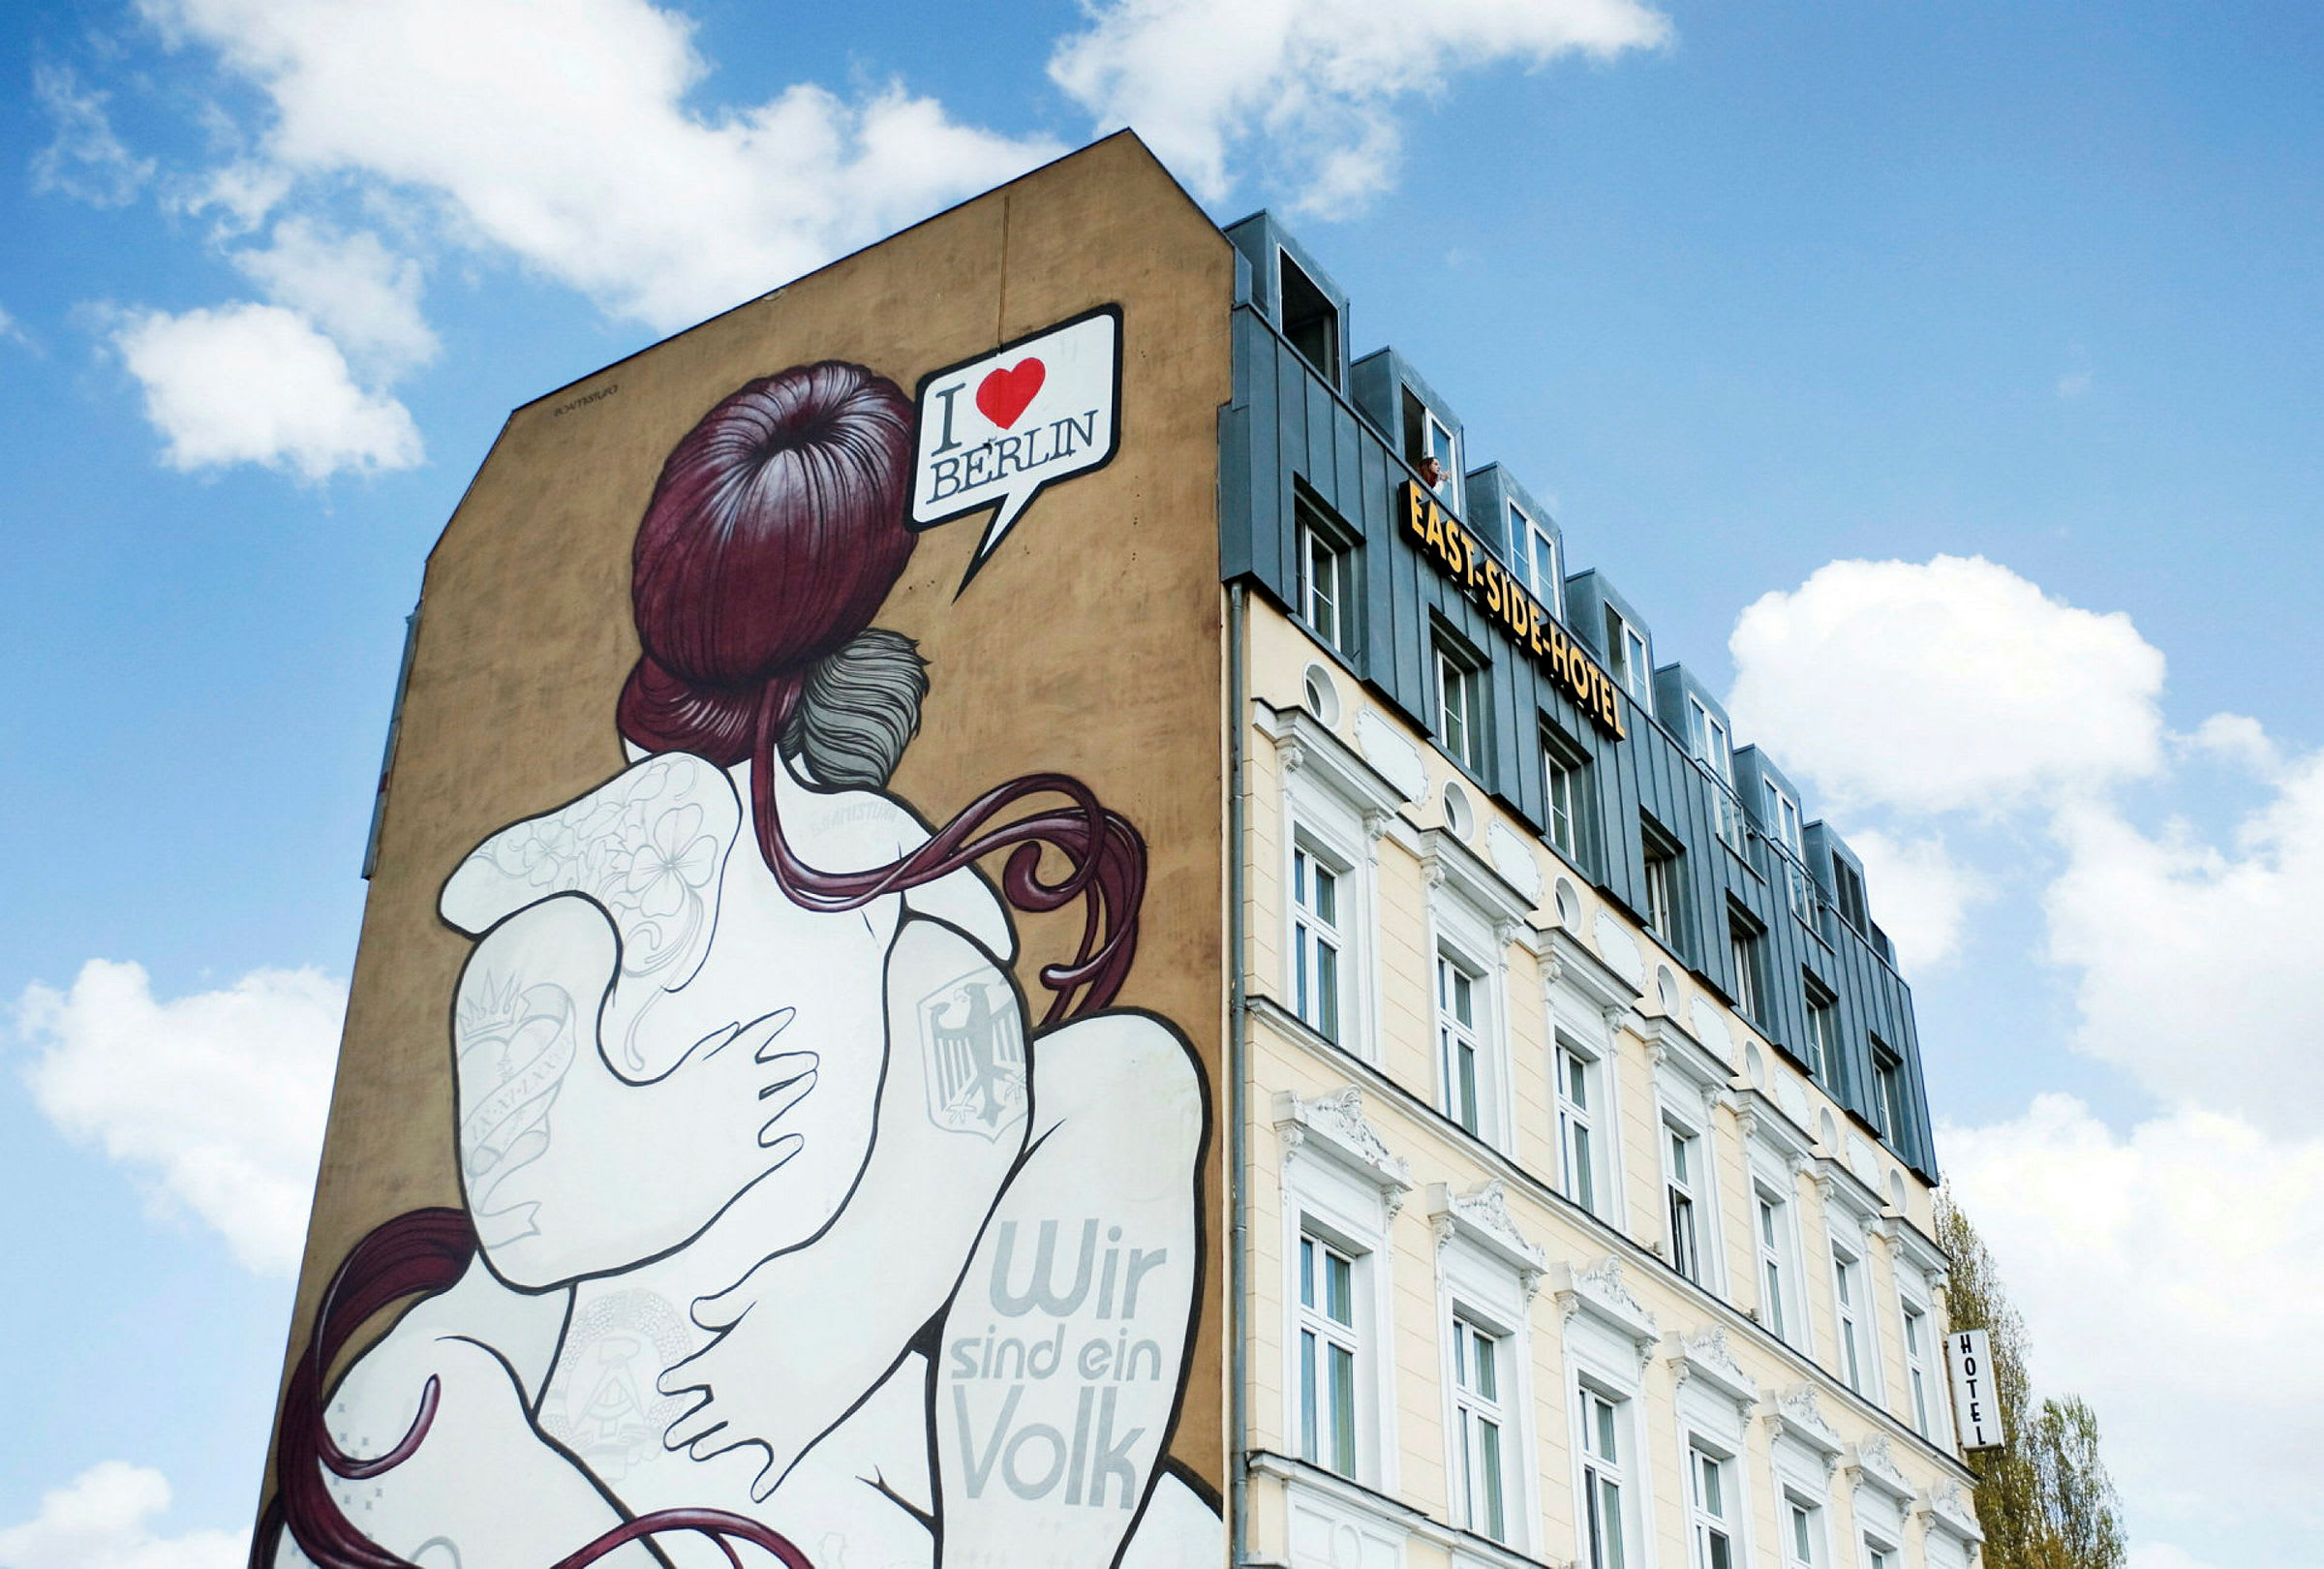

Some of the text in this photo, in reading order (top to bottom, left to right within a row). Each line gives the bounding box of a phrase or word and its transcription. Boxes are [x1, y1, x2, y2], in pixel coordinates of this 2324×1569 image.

[926, 410, 1099, 505] BERLIN
[931, 383, 966, 456] I
[1408, 479, 1626, 740] EAST-SIDE-HOTEL
[990, 1217, 1168, 1320] Wir
[950, 1323, 1162, 1382] sind ein
[1960, 1334, 1986, 1446] HOTEL
[952, 1384, 1147, 1510] Volk
